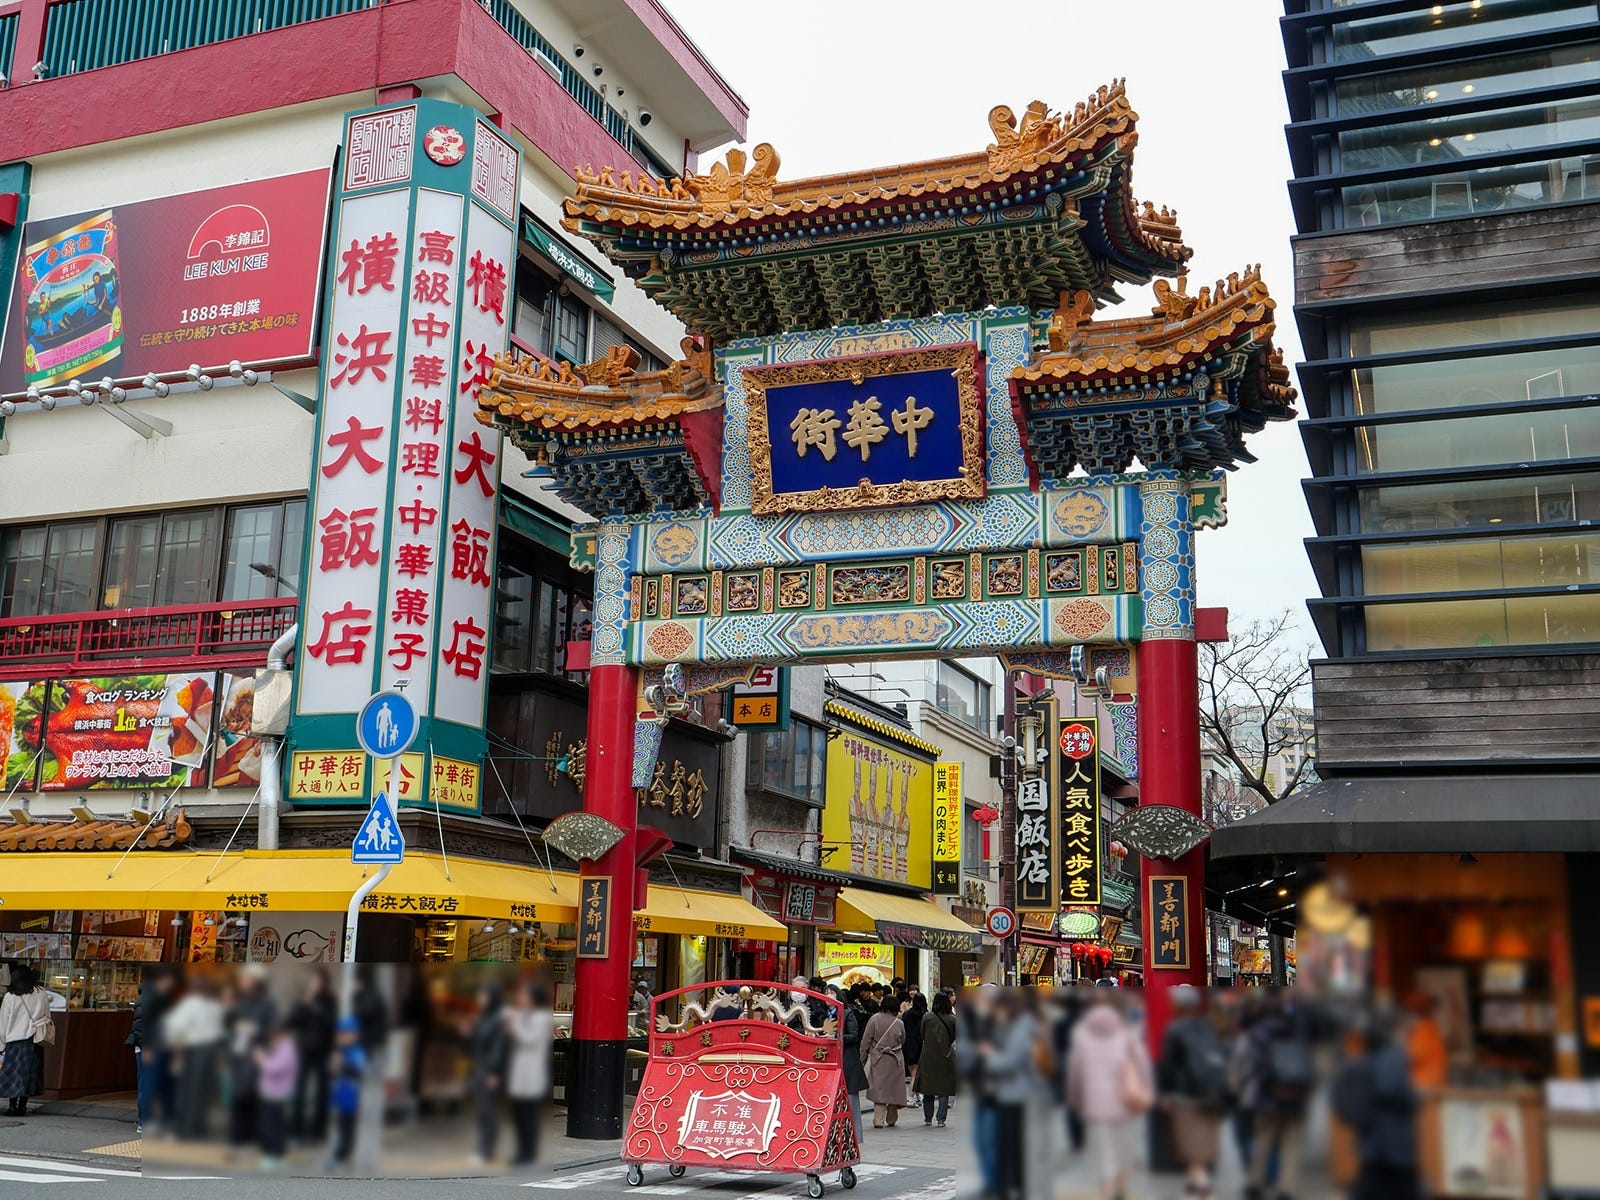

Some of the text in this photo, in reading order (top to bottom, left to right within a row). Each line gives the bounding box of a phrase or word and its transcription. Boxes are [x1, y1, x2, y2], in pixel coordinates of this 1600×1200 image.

[225, 229, 264, 248] 李錦記
[184, 253, 269, 281] LEE KUM KEE
[180, 299, 261, 324] 1888年創業
[140, 313, 299, 347] 伝統を守り続けてきた本場の味
[789, 396, 935, 462] 中華街
[307, 231, 399, 666] 横浜大飯店
[388, 230, 455, 671] 高級中華料理・中華菓子
[86, 688, 168, 704] 食べログ ランキング
[114, 707, 137, 731] 1位
[738, 703, 771, 717] 本店
[1064, 733, 1090, 741] 中華街
[1065, 741, 1091, 752] 名物
[72, 749, 165, 764] 素材と味にこだわった
[66, 762, 172, 777] ワンランク上の食べ放題
[298, 756, 362, 777] 中華街
[433, 761, 475, 788] 中華街
[296, 780, 360, 793] 大通り入口
[431, 787, 473, 802] 大通り入口
[936, 768, 947, 856] 世界一の肉まん
[948, 765, 959, 859] 中国料理世界チャンピオン
[1065, 761, 1093, 898] 人気食べ歩き
[360, 894, 460, 912] 横浜大飯店
[993, 915, 1010, 930] 30
[710, 1104, 752, 1119] 不准
[692, 1119, 762, 1136] 車馬駛入
[692, 1136, 756, 1147] 加賀町警察署
